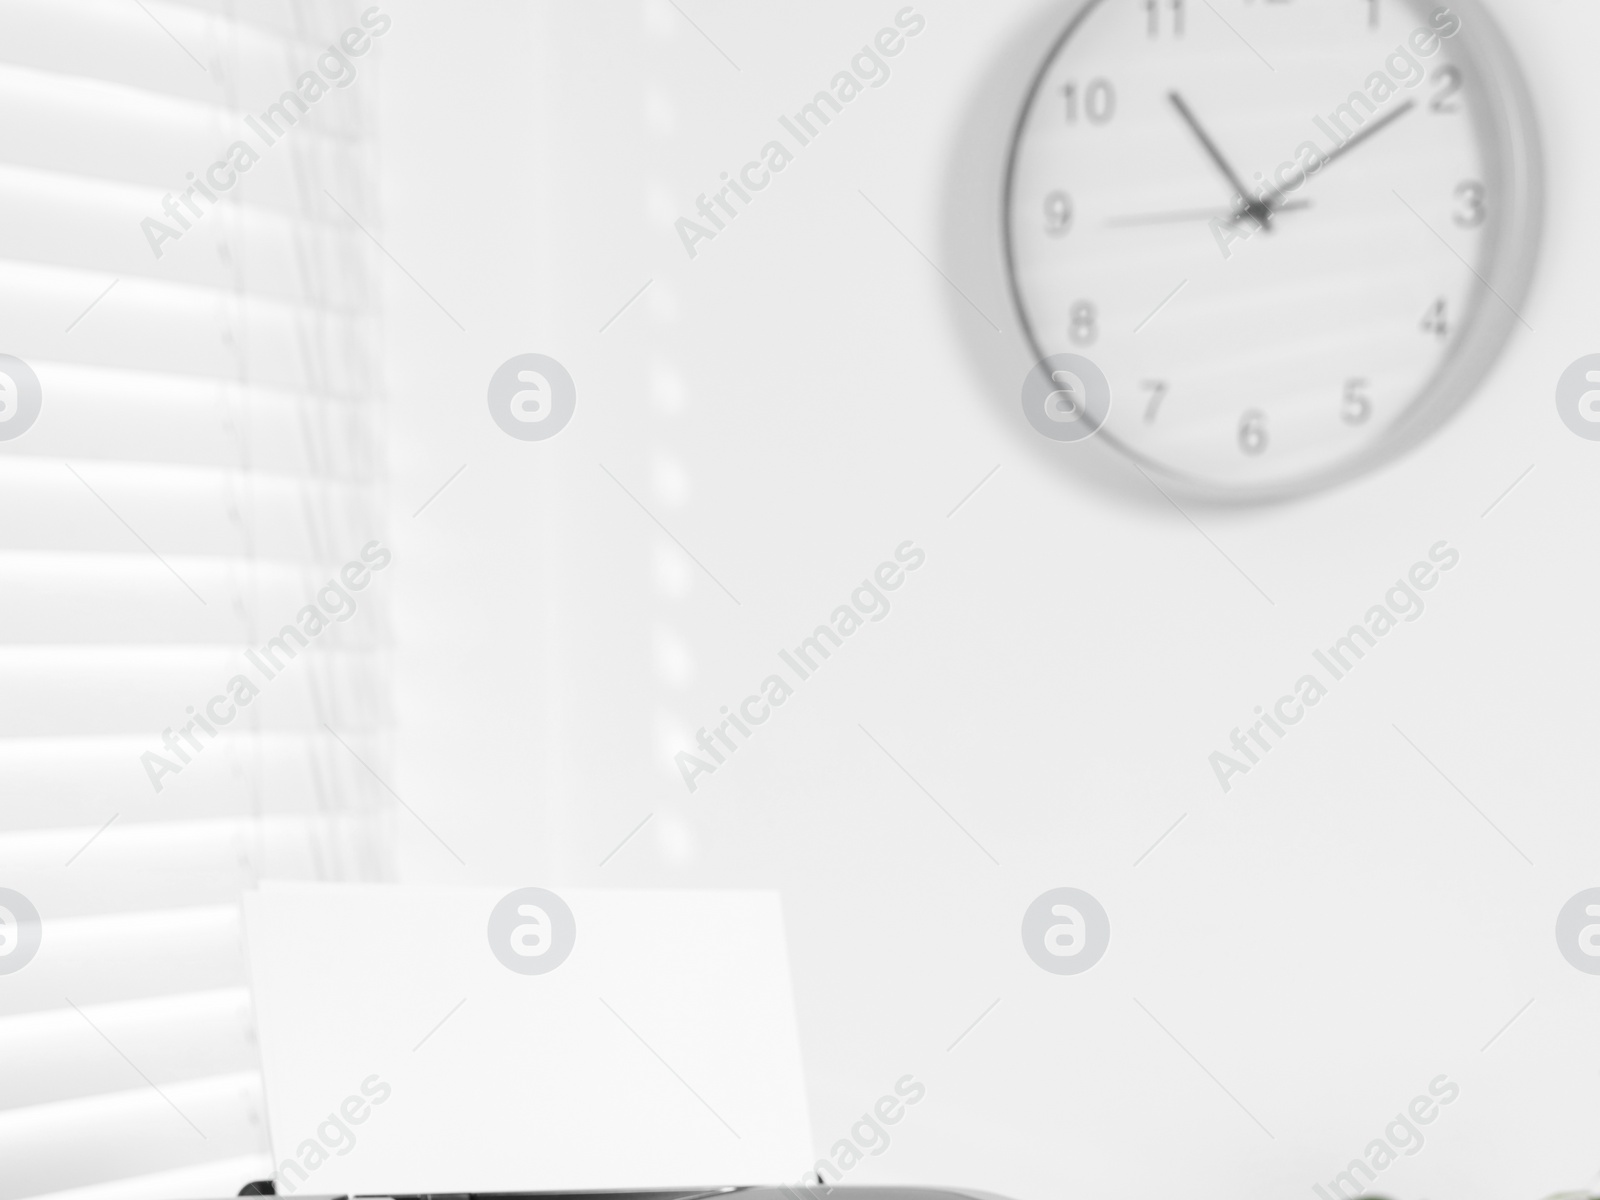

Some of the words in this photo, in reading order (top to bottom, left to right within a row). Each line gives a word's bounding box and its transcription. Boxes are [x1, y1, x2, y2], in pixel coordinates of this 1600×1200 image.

[1145, 0, 1186, 39] 11
[1058, 77, 1117, 126] 10
[1427, 64, 1463, 115] 2
[1042, 190, 1074, 238] 9
[1451, 179, 1487, 229] 3
[1067, 300, 1099, 347] 8
[1419, 297, 1450, 338] 4
[1140, 379, 1168, 425] 7
[1340, 376, 1371, 426] 5
[1237, 409, 1269, 457] 6
